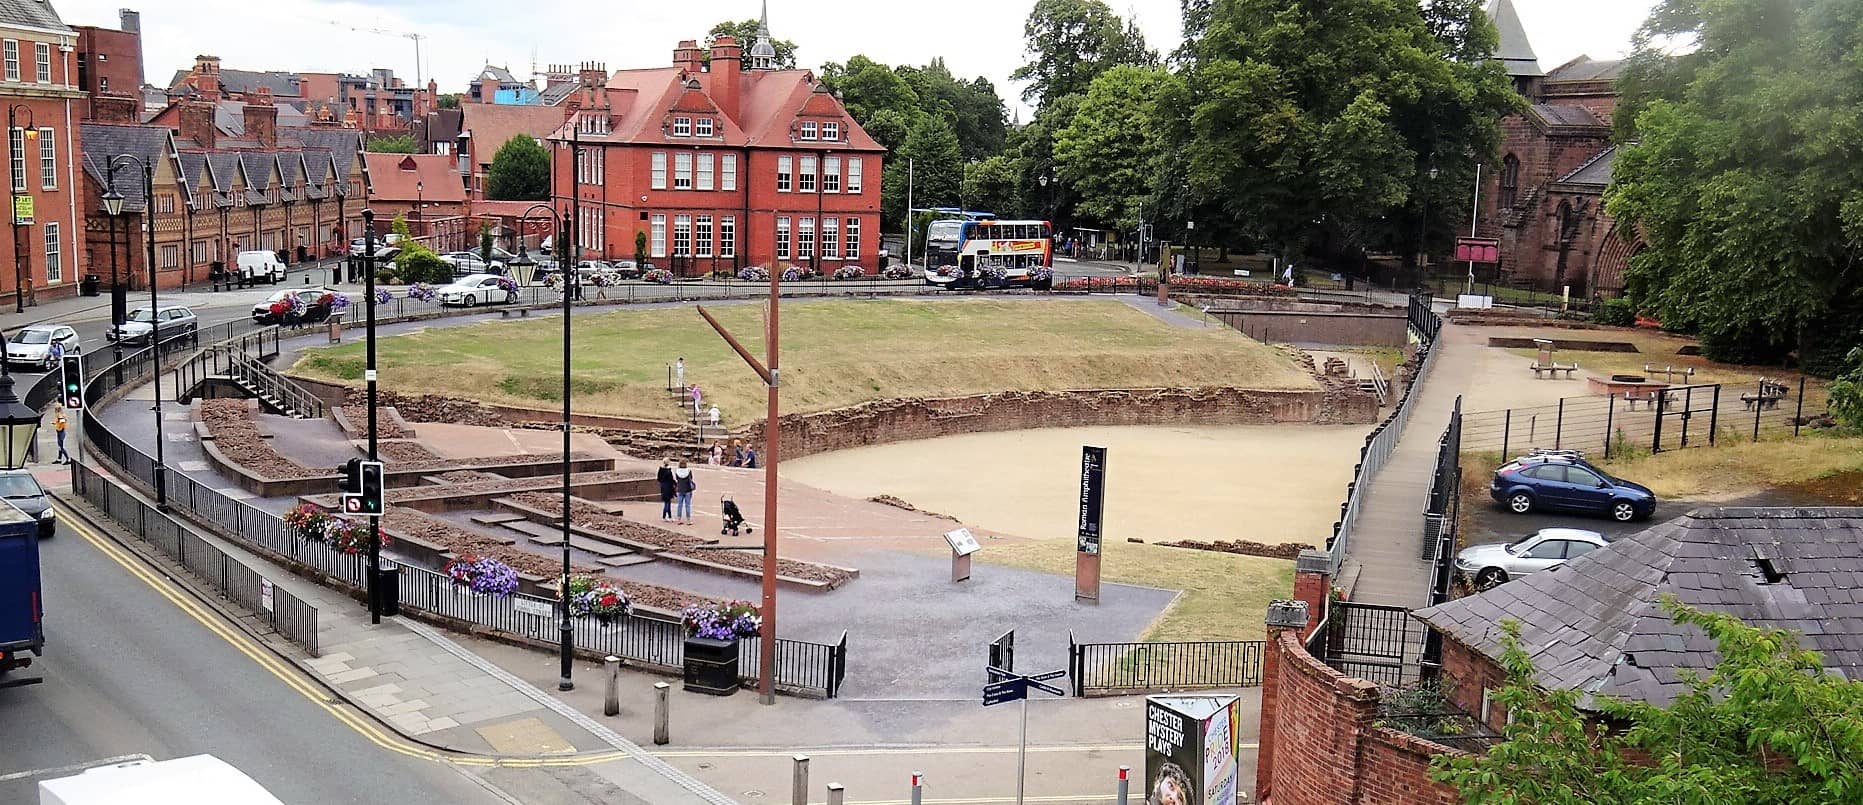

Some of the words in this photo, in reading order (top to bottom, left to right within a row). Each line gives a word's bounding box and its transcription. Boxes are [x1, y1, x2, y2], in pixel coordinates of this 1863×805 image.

[1081, 453, 1091, 503] Amphitheatre
[1080, 504, 1088, 530] Roman
[1149, 705, 1183, 732] CHESTER
[1149, 720, 1184, 748] MYSTERY
[1149, 734, 1172, 757] PLAYS
[1205, 725, 1229, 763] PRIDE
[1213, 742, 1230, 770] 2018
[1208, 775, 1233, 800] SATURDAY
